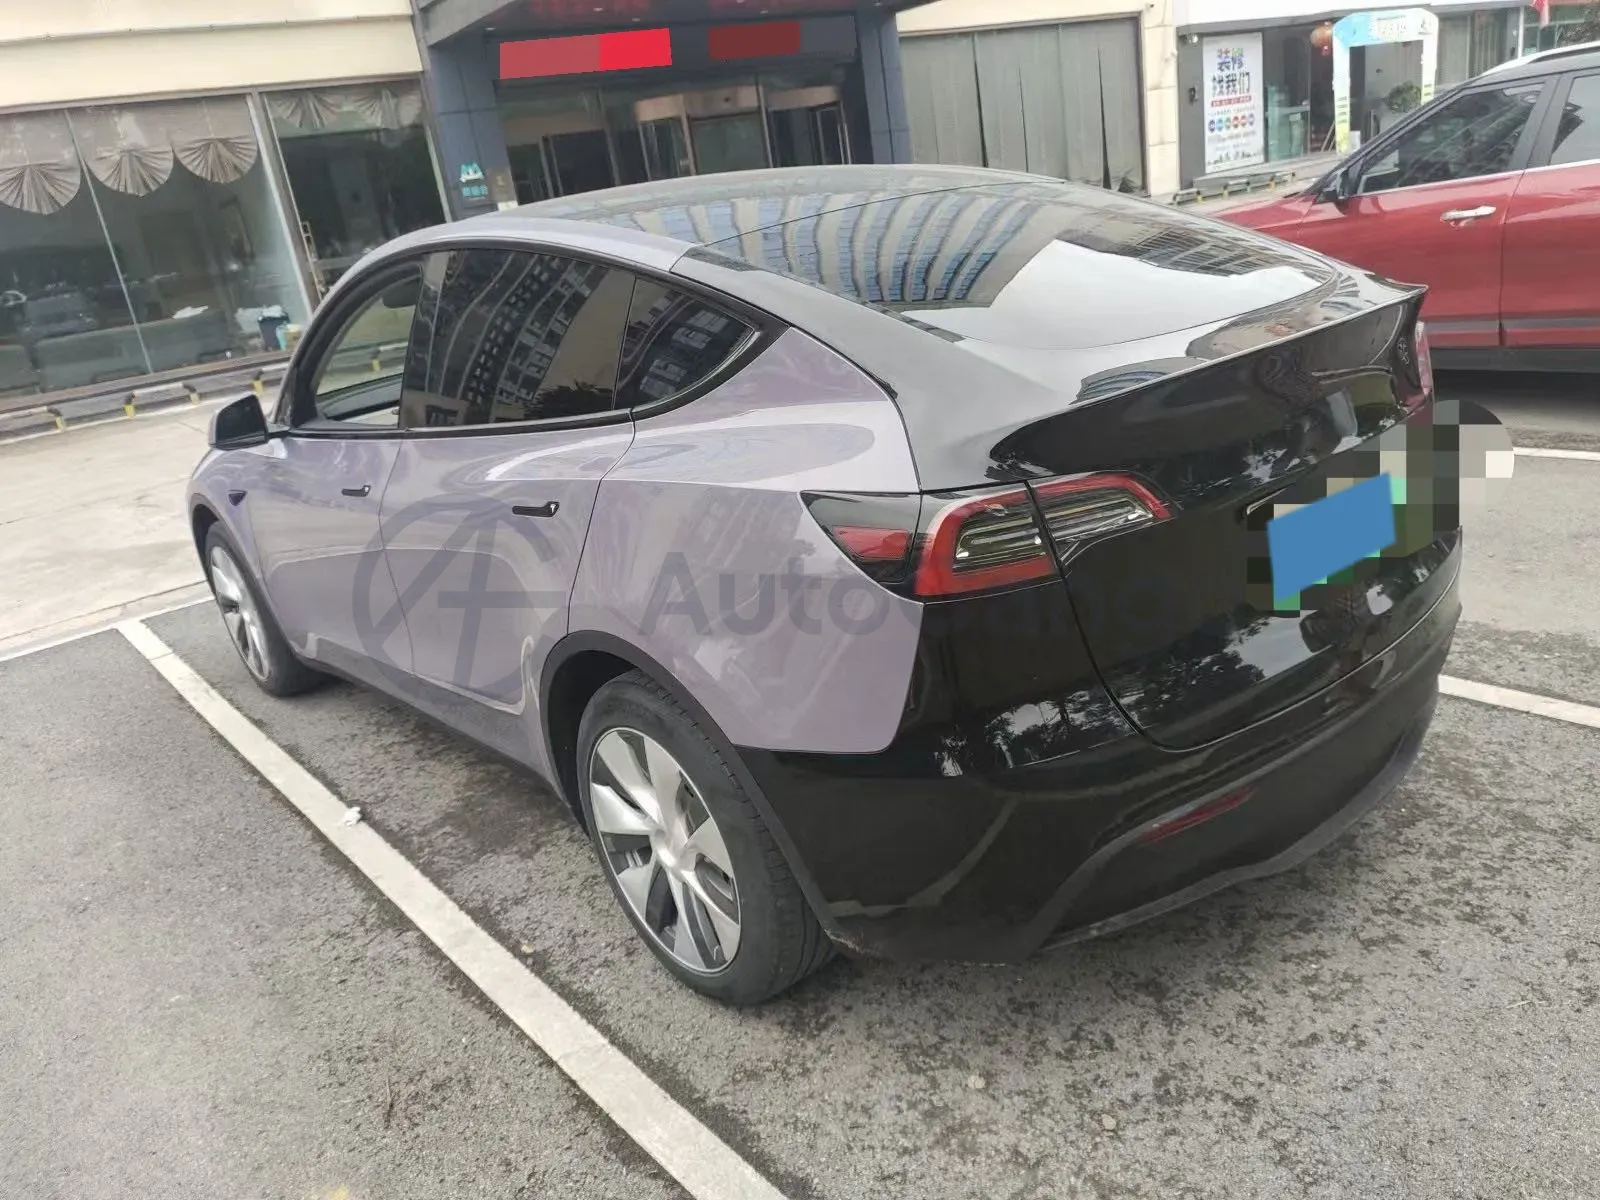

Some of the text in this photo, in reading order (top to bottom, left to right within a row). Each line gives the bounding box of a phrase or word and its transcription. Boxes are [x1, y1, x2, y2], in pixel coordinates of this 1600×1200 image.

[1217, 47, 1244, 72] 装修
[1212, 72, 1251, 98] 找我们
